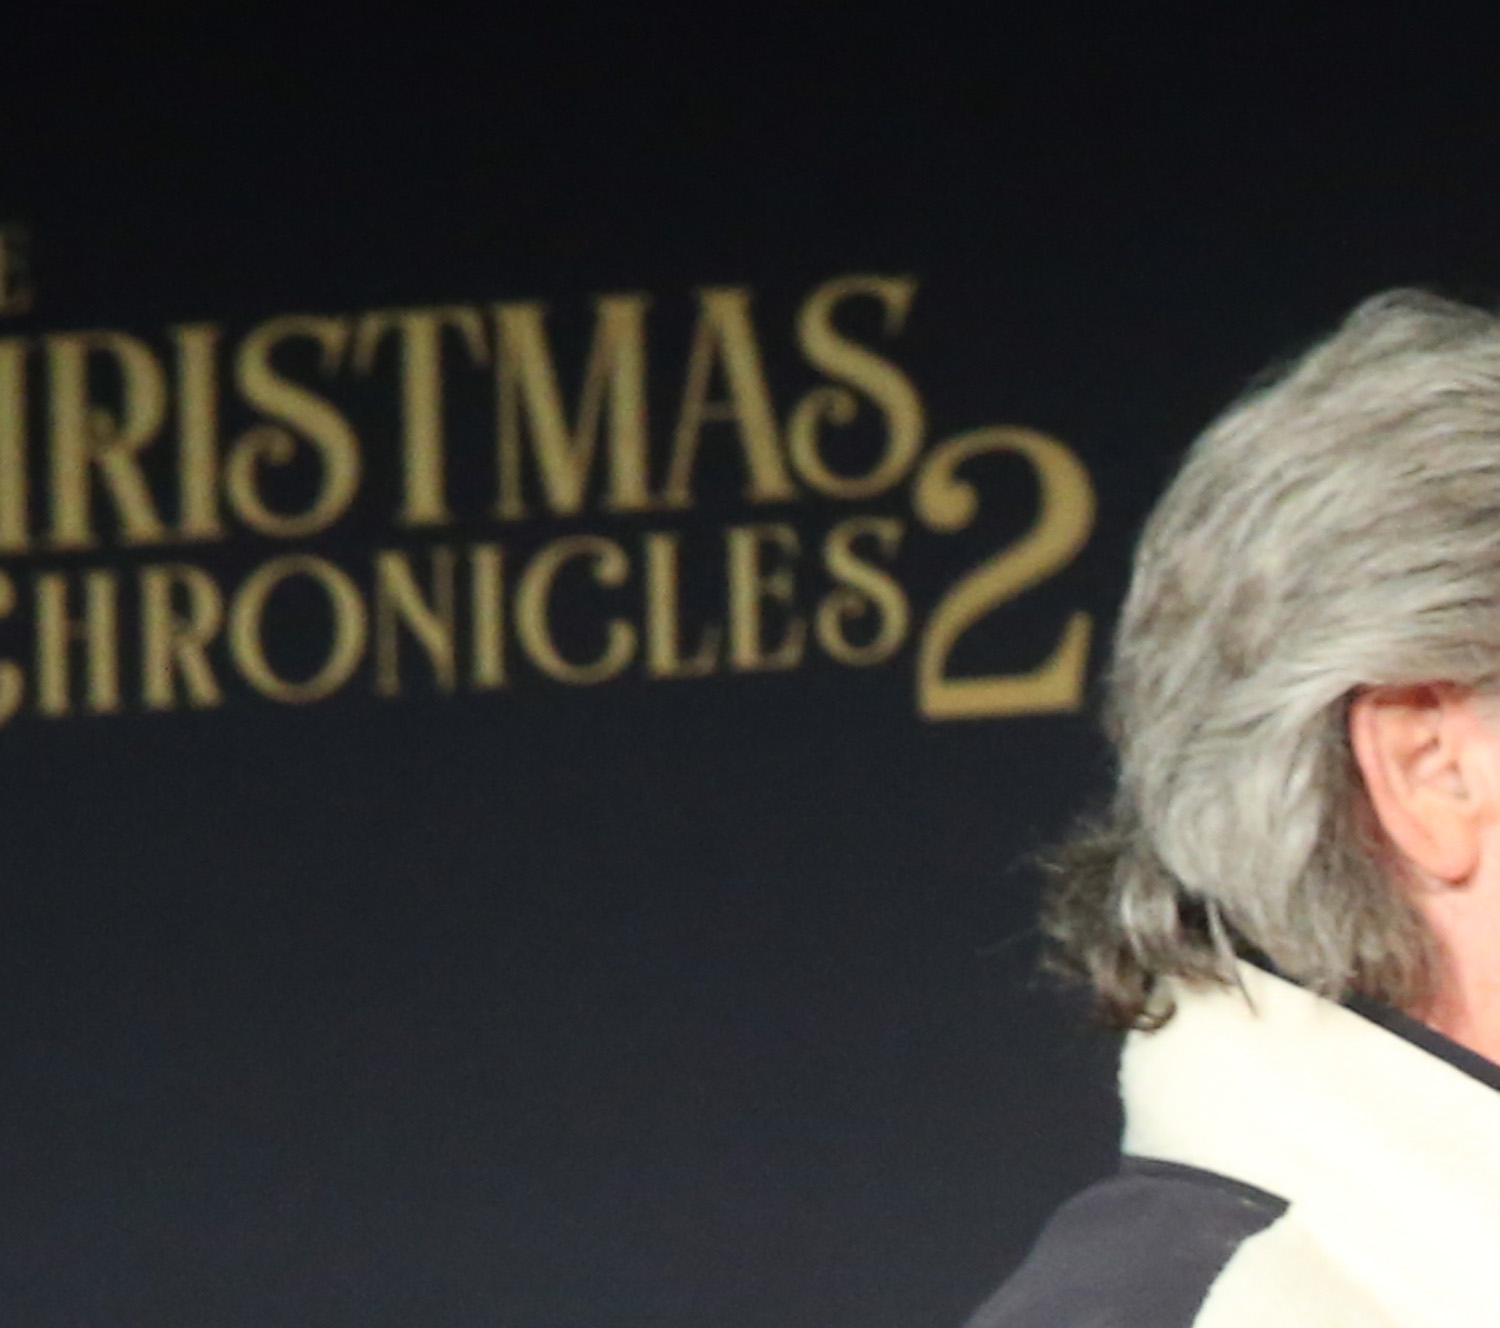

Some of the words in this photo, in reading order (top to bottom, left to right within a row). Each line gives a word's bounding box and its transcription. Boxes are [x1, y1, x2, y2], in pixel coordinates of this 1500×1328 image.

[0, 274, 925, 554] RISTMAS
[0, 514, 911, 728] HRONICLES
[911, 424, 1096, 722] 2
